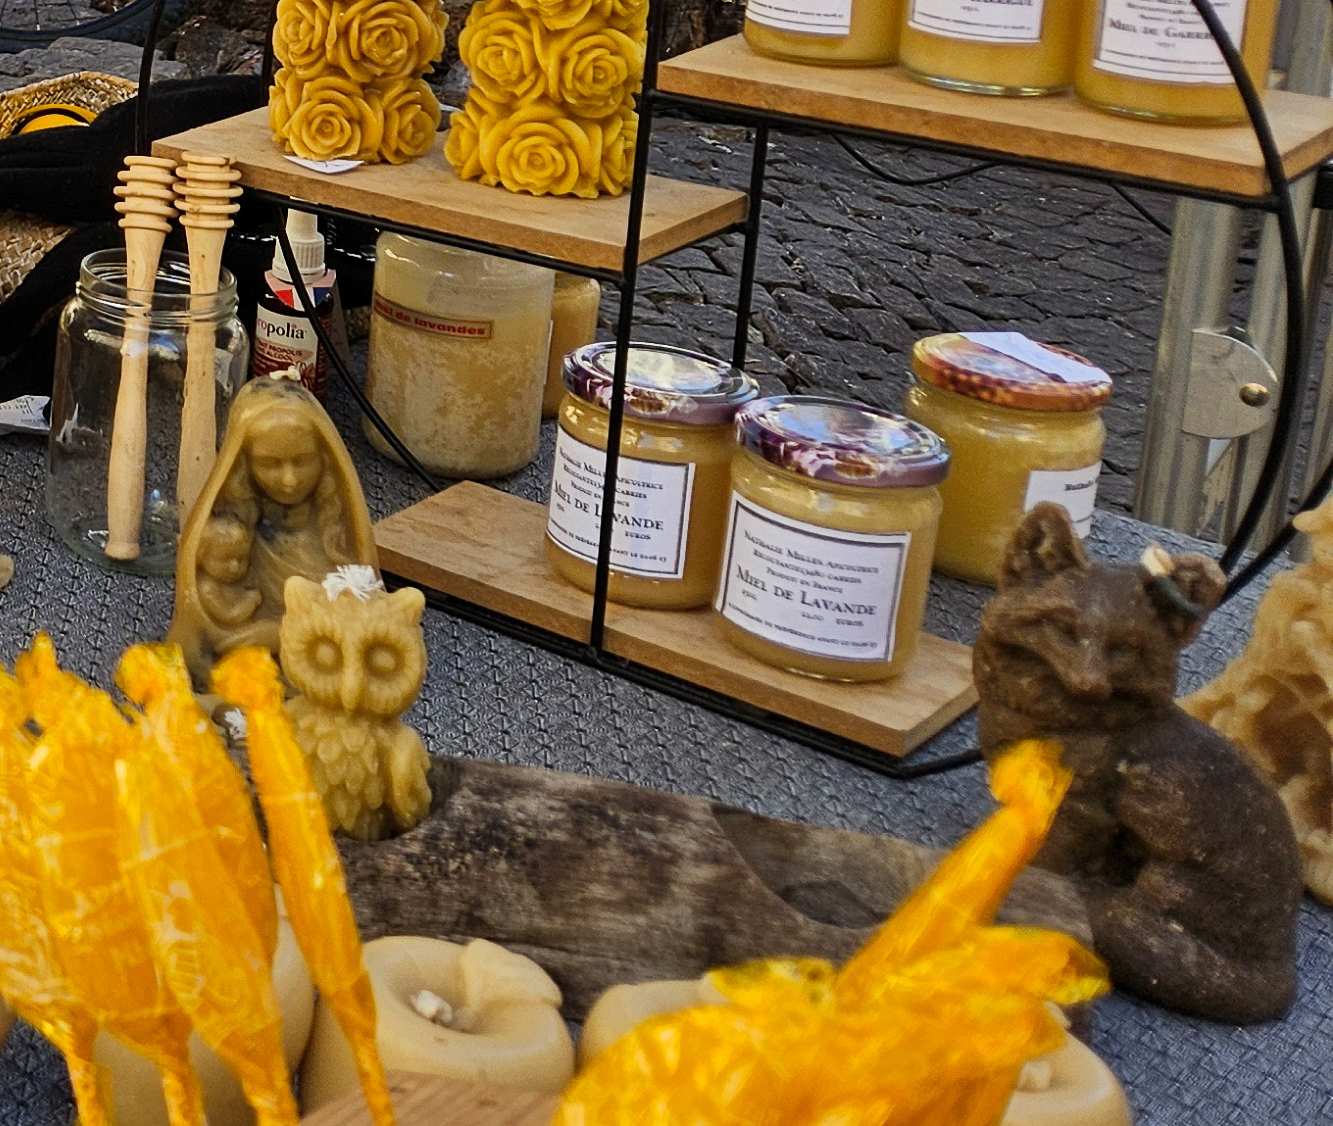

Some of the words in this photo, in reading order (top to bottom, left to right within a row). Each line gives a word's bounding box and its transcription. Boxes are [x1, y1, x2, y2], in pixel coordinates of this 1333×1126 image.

[415, 318, 485, 334] lavandes
[595, 503, 663, 531] LVANDE
[773, 585, 794, 601] DE
[800, 590, 877, 616] LAVANDE
